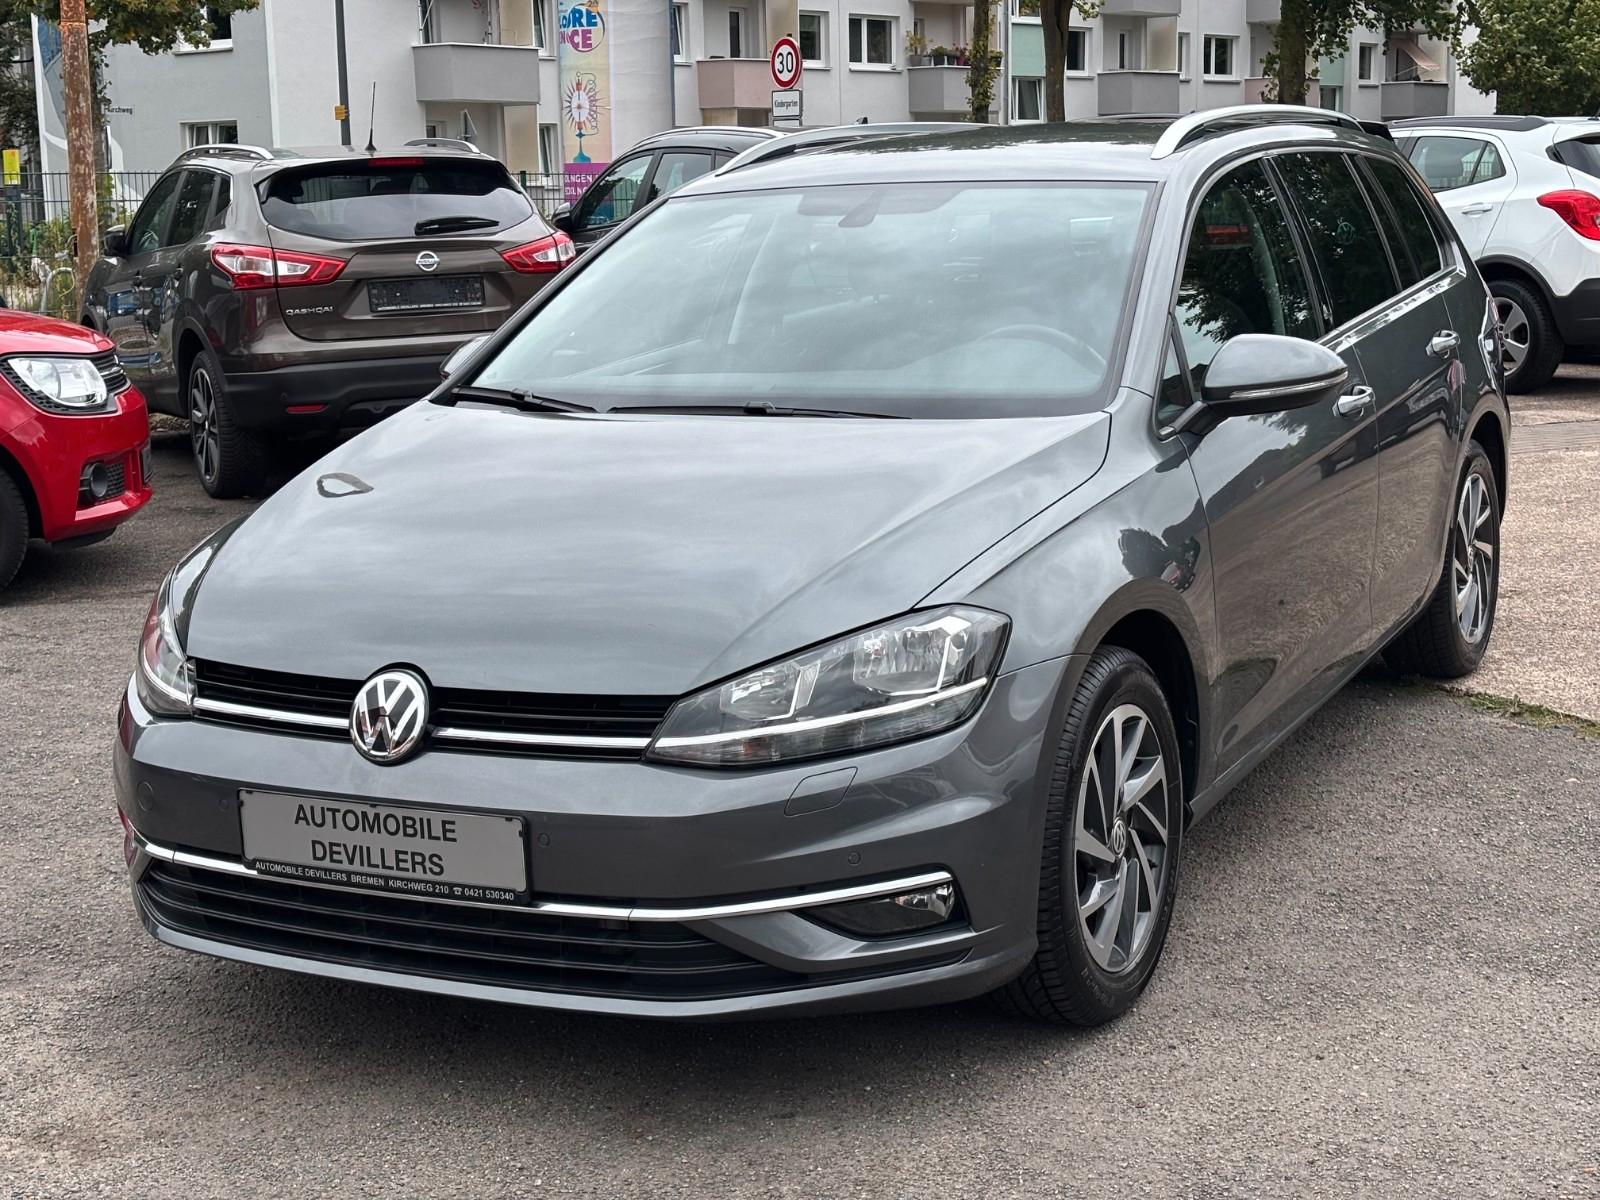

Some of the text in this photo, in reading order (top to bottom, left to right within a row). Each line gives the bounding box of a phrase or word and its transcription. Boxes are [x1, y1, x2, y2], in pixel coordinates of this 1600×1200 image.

[777, 51, 794, 74] 30
[774, 98, 799, 110] Kindergarten
[285, 305, 334, 317] QASHQAI
[294, 804, 458, 842] AUTOMOBILE
[311, 840, 445, 877] DEVILLERS
[254, 860, 514, 902] AUTOMOBILE DEVILLERS BREMEN KIRCHWEG 210 0421 530340
